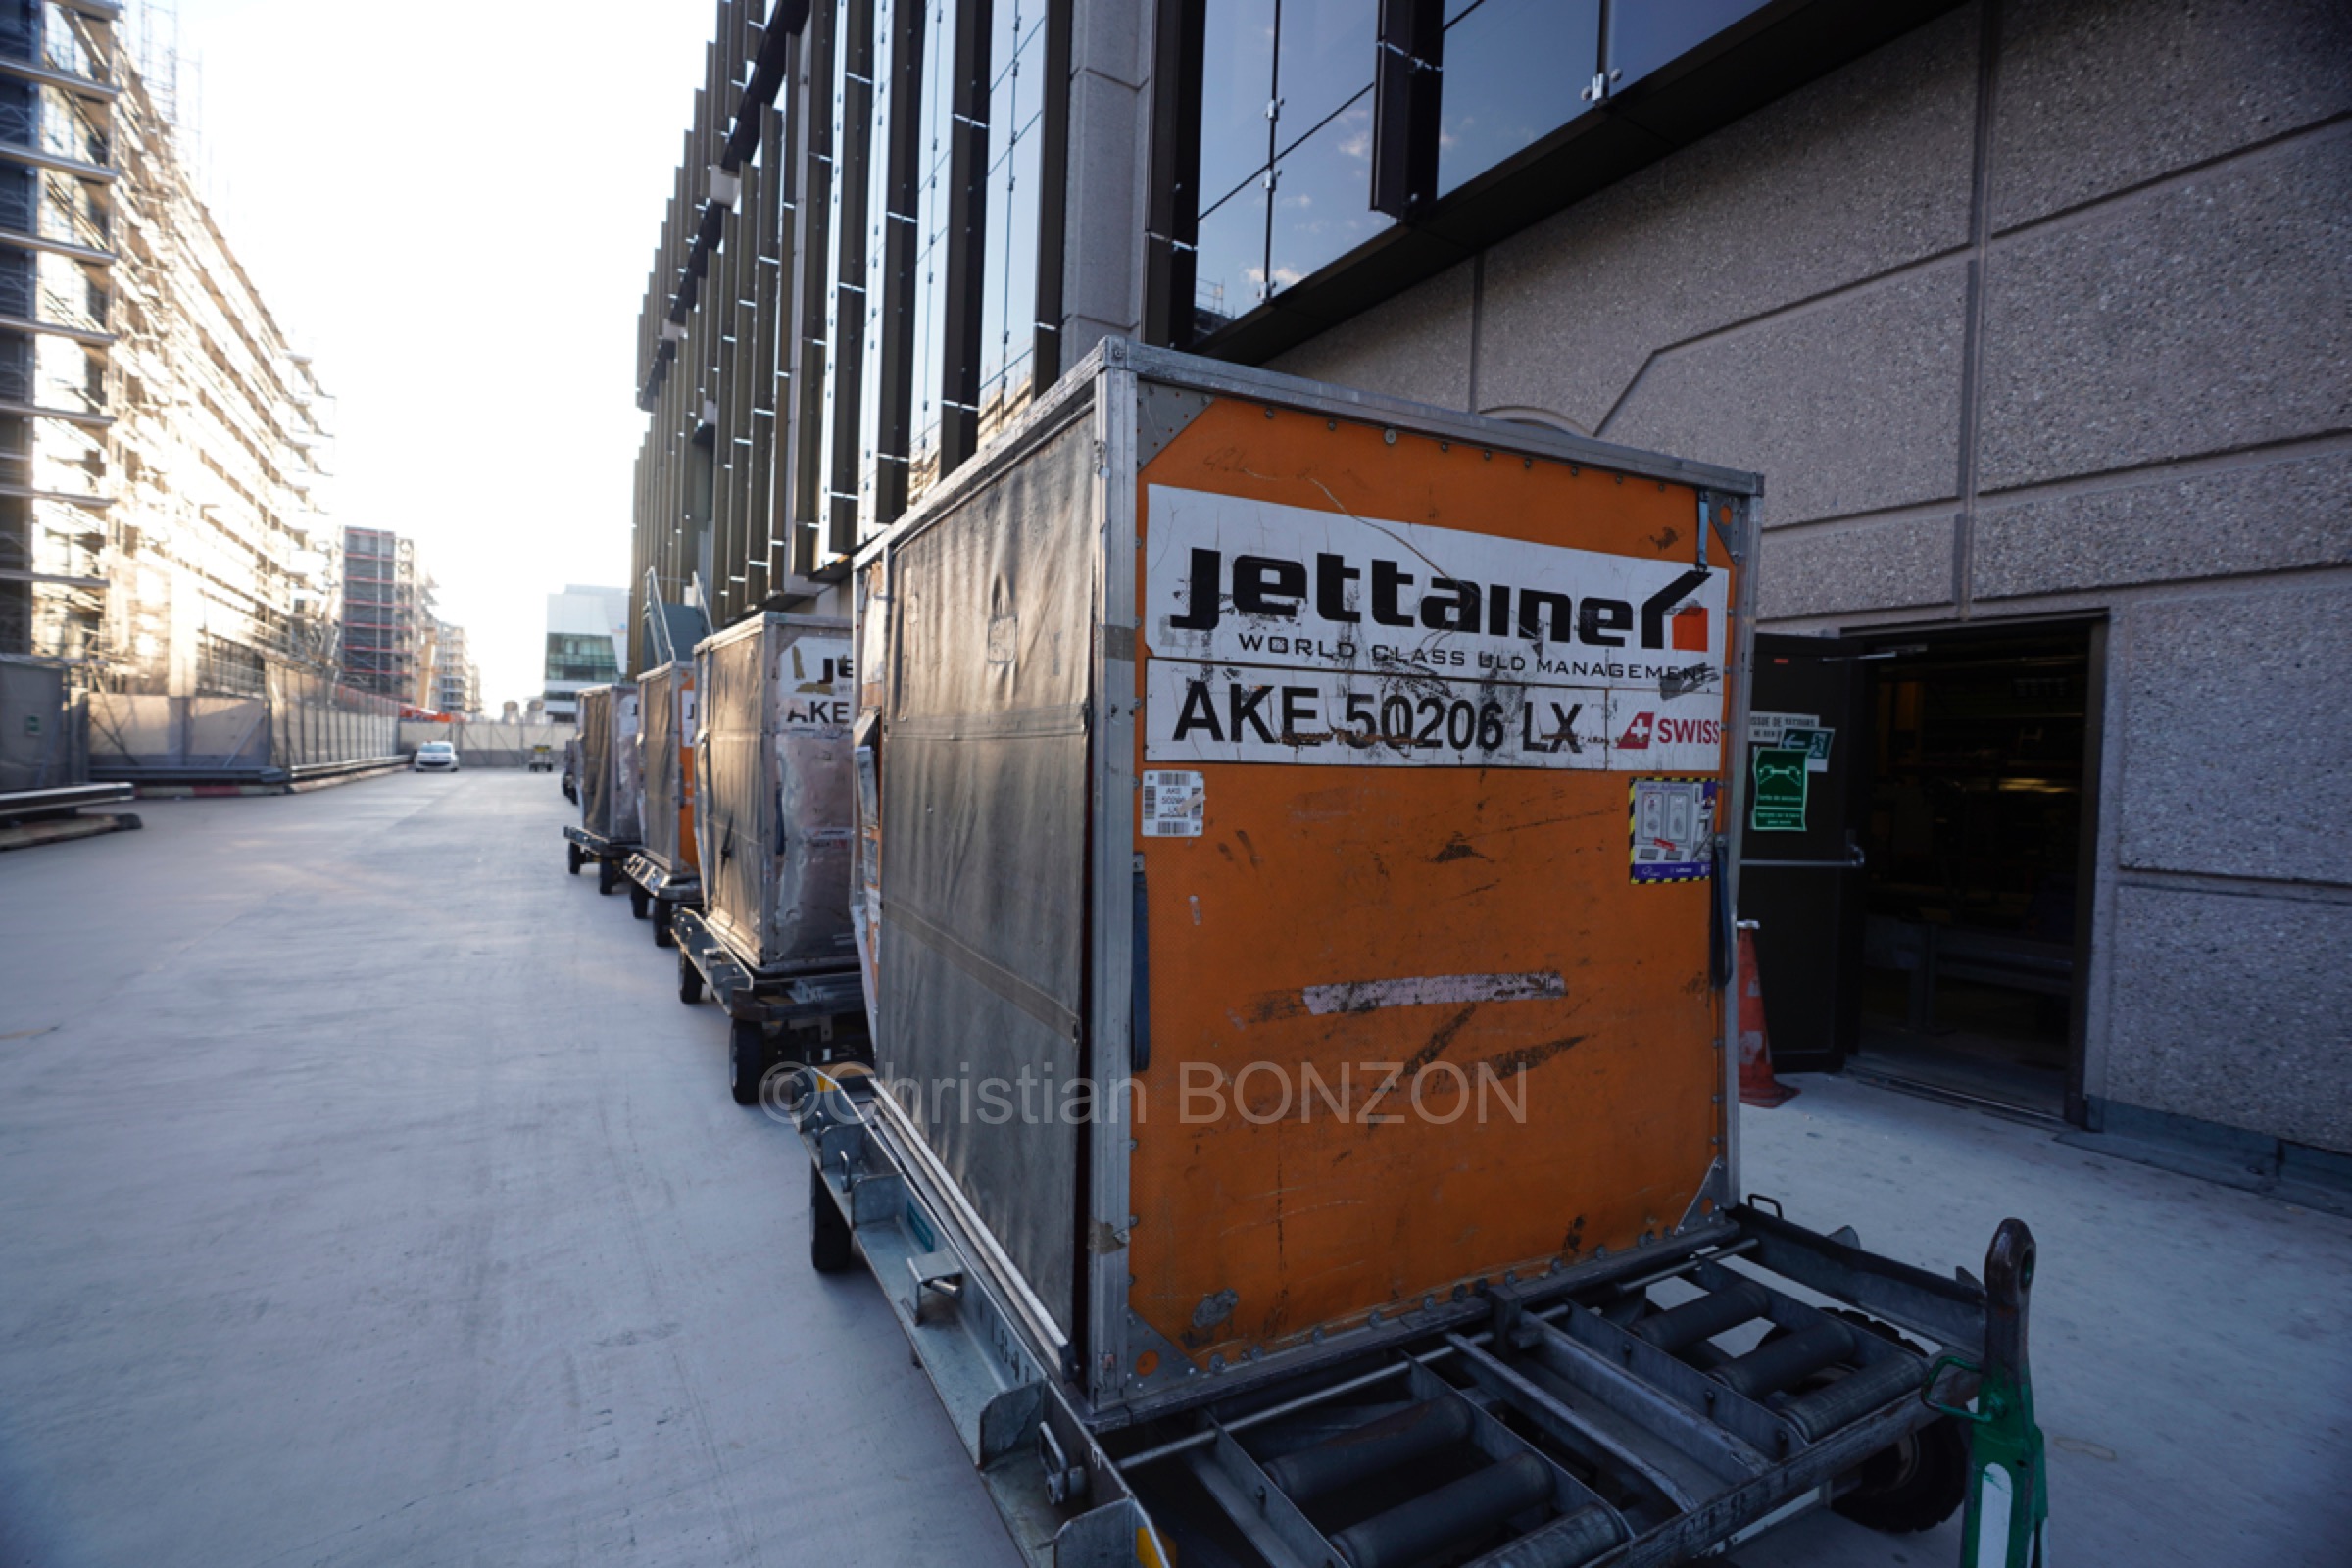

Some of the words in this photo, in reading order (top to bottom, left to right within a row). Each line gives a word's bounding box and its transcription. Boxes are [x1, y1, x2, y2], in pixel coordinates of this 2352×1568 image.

[1238, 632, 1356, 659] WORLD
[1372, 643, 1466, 667] CLASS
[1536, 657, 1716, 682] MANAGEMENT
[1171, 679, 1322, 748] AKE
[1346, 692, 1505, 752] 50206
[1521, 701, 1584, 754] LX
[1657, 717, 1720, 745] SWISS
